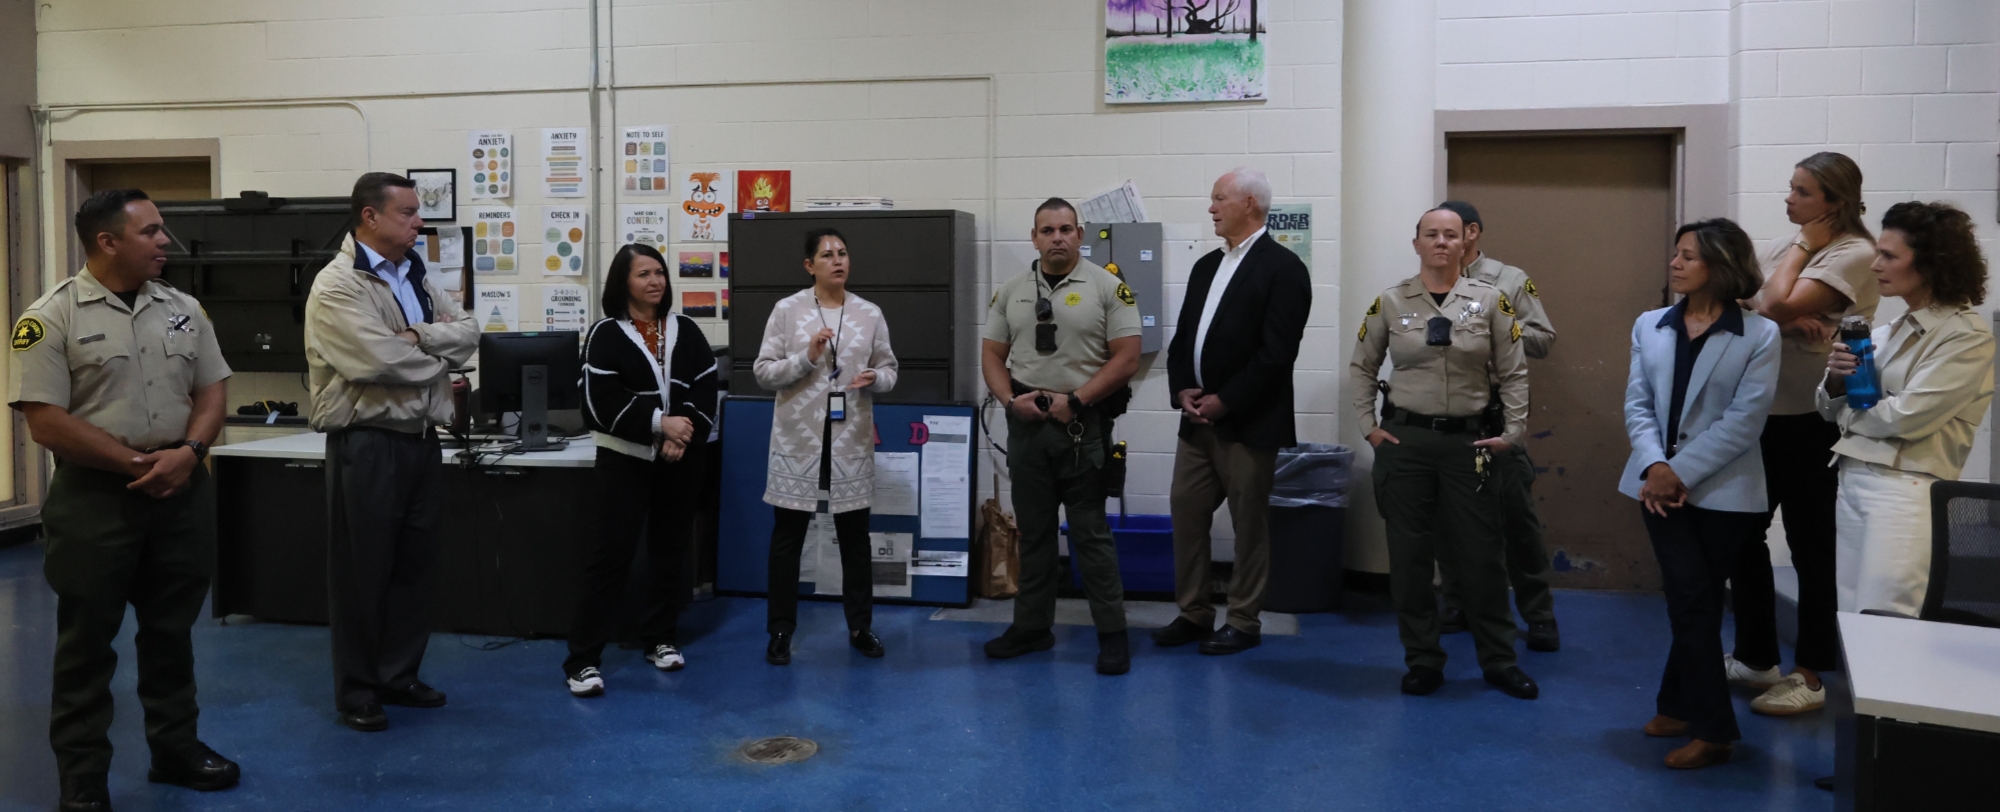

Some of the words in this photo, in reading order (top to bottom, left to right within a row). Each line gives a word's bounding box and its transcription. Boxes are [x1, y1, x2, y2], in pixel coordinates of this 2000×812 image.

[478, 137, 505, 145] ANXIETY
[478, 211, 511, 219] REMINDERS
[550, 211, 570, 219] CHECK
[1268, 213, 1309, 222] RDER
[626, 216, 664, 224] CONTROL?
[1266, 221, 1309, 230] NLINE!
[481, 290, 511, 298] MASLOW'S
[909, 422, 929, 445] D
